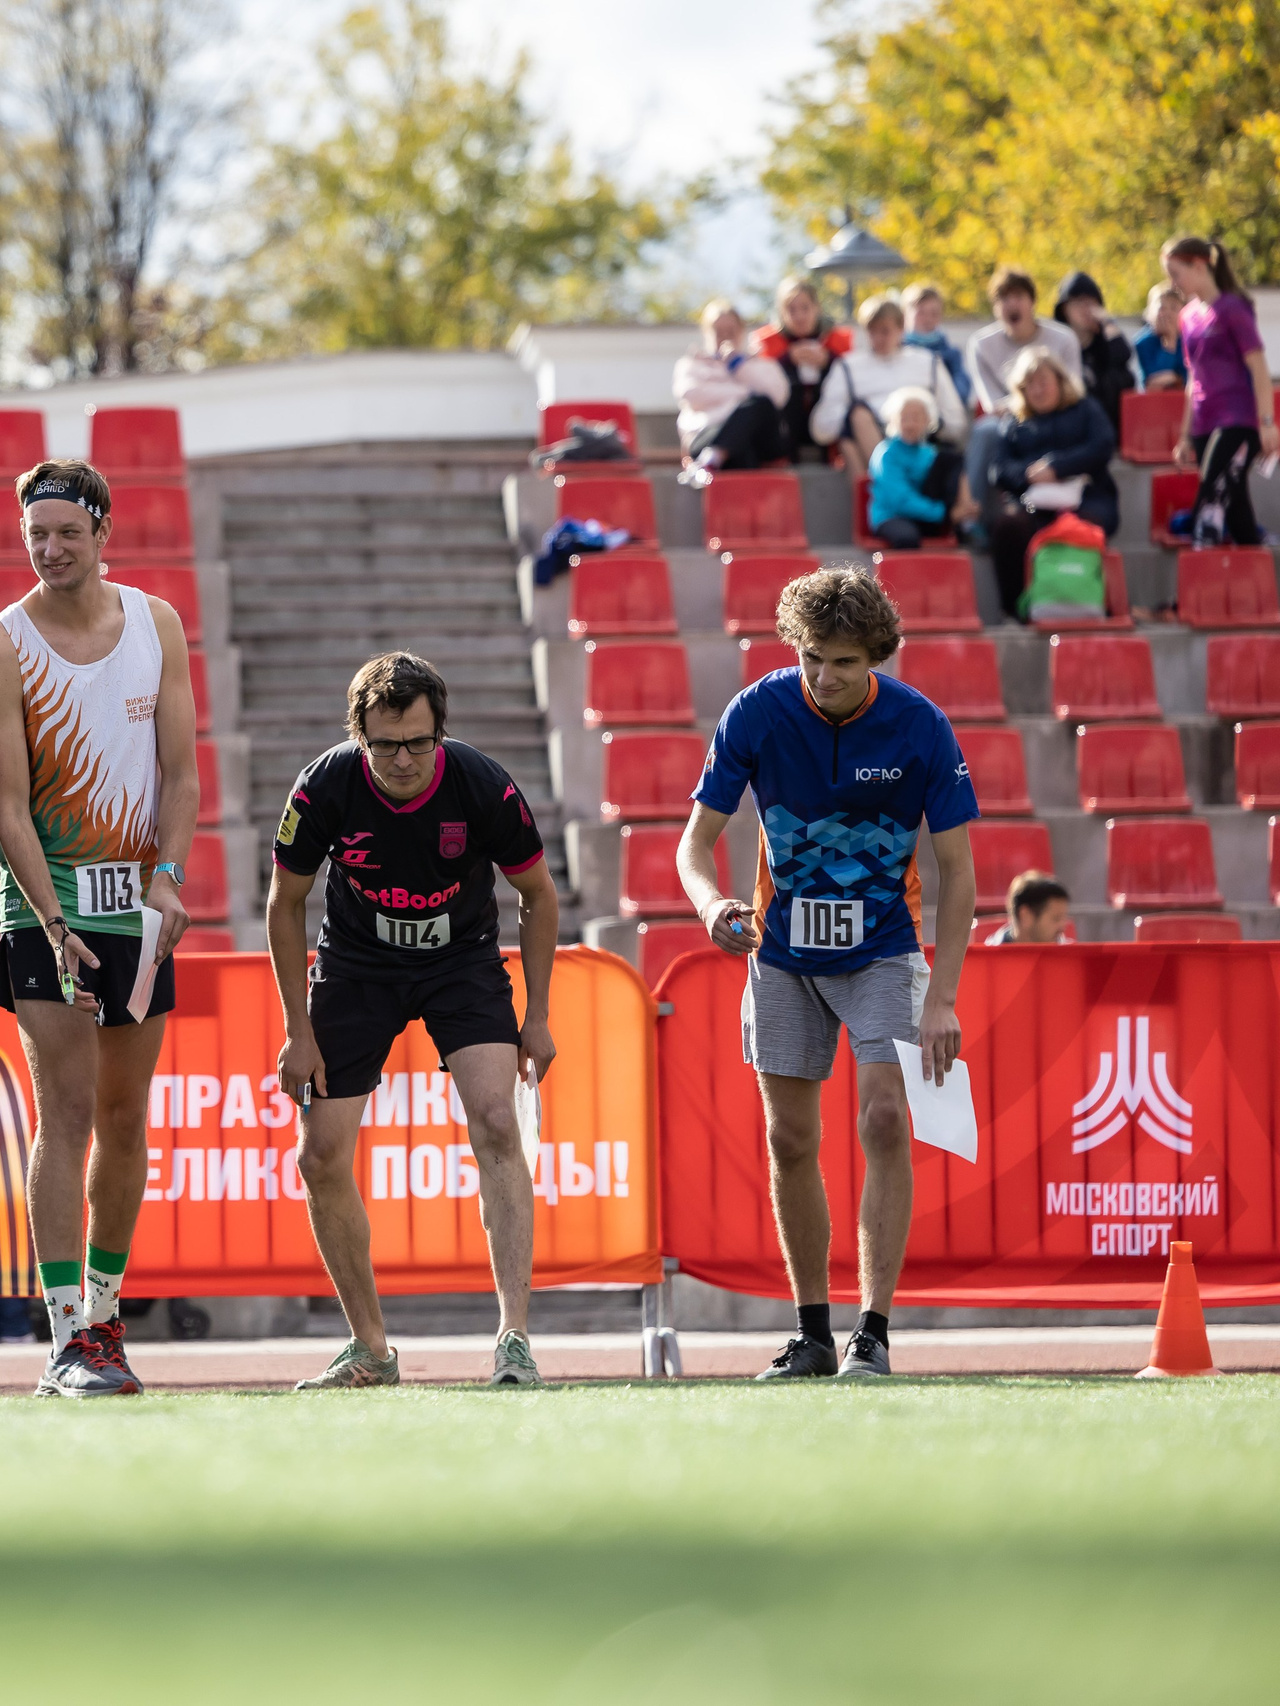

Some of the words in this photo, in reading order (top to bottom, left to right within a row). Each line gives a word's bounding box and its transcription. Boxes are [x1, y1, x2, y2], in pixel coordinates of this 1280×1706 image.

[37, 486, 65, 495] BAND
[125, 695, 148, 707] ВИЖУ
[127, 706, 137, 715] НЕ
[129, 711, 155, 724] ПРЕПЯТ
[86, 867, 134, 914] 103
[386, 919, 441, 948] 104
[801, 900, 853, 947] 105
[371, 1141, 629, 1206] ПОБДЫ!
[1046, 1175, 1218, 1216] МОСКОВСКИЙ
[1091, 1222, 1173, 1256] СПОРТ
